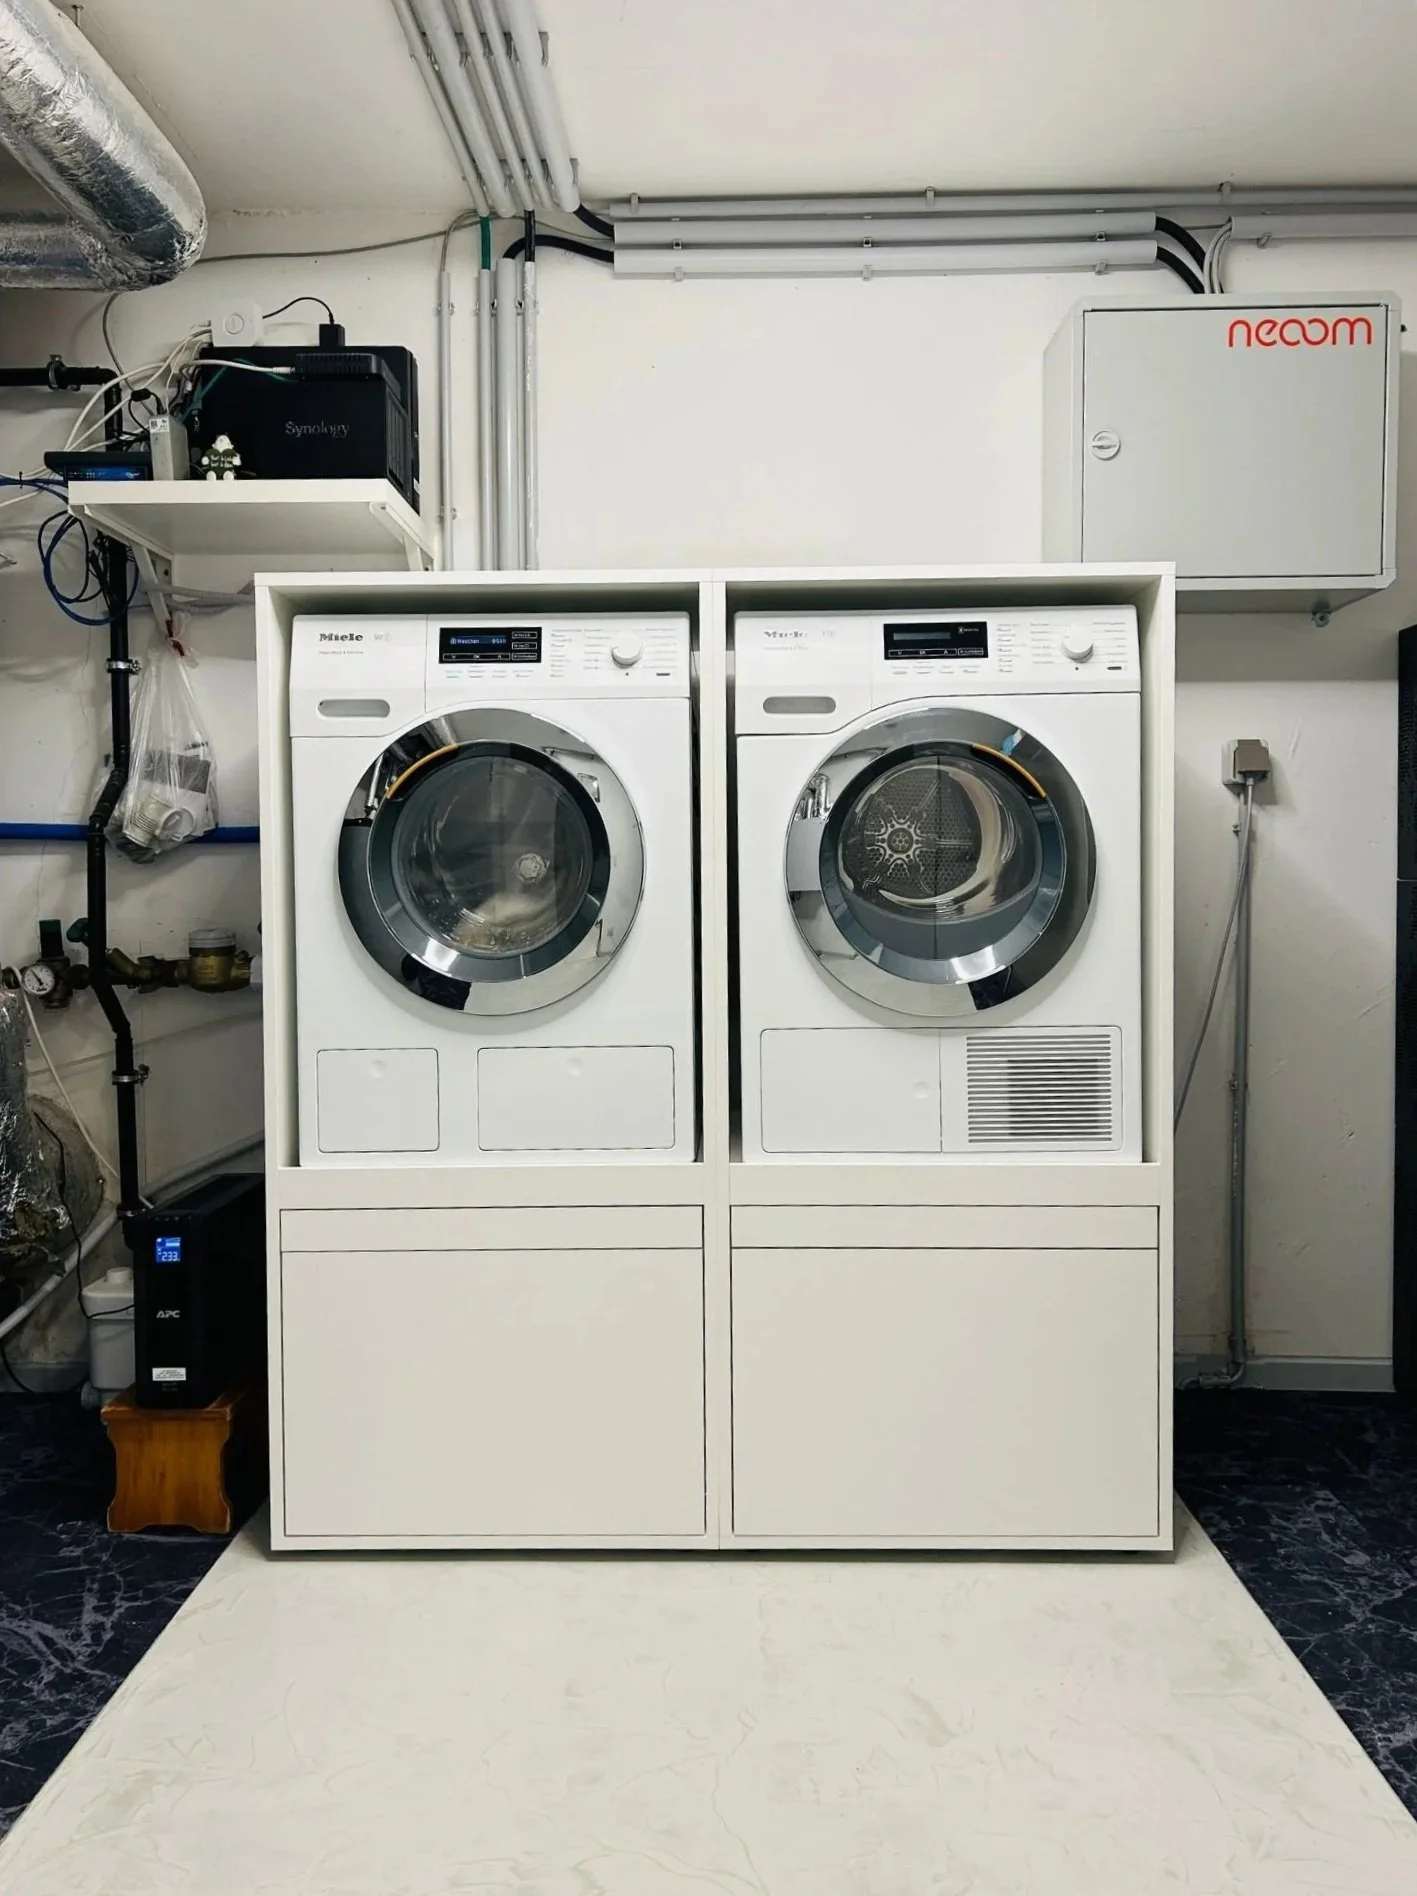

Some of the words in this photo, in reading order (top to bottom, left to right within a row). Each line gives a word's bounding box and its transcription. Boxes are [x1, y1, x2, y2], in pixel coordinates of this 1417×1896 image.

[285, 420, 350, 439] Synology
[319, 632, 364, 642] Miele
[161, 1251, 178, 1262] 233
[156, 1310, 180, 1319] APC
